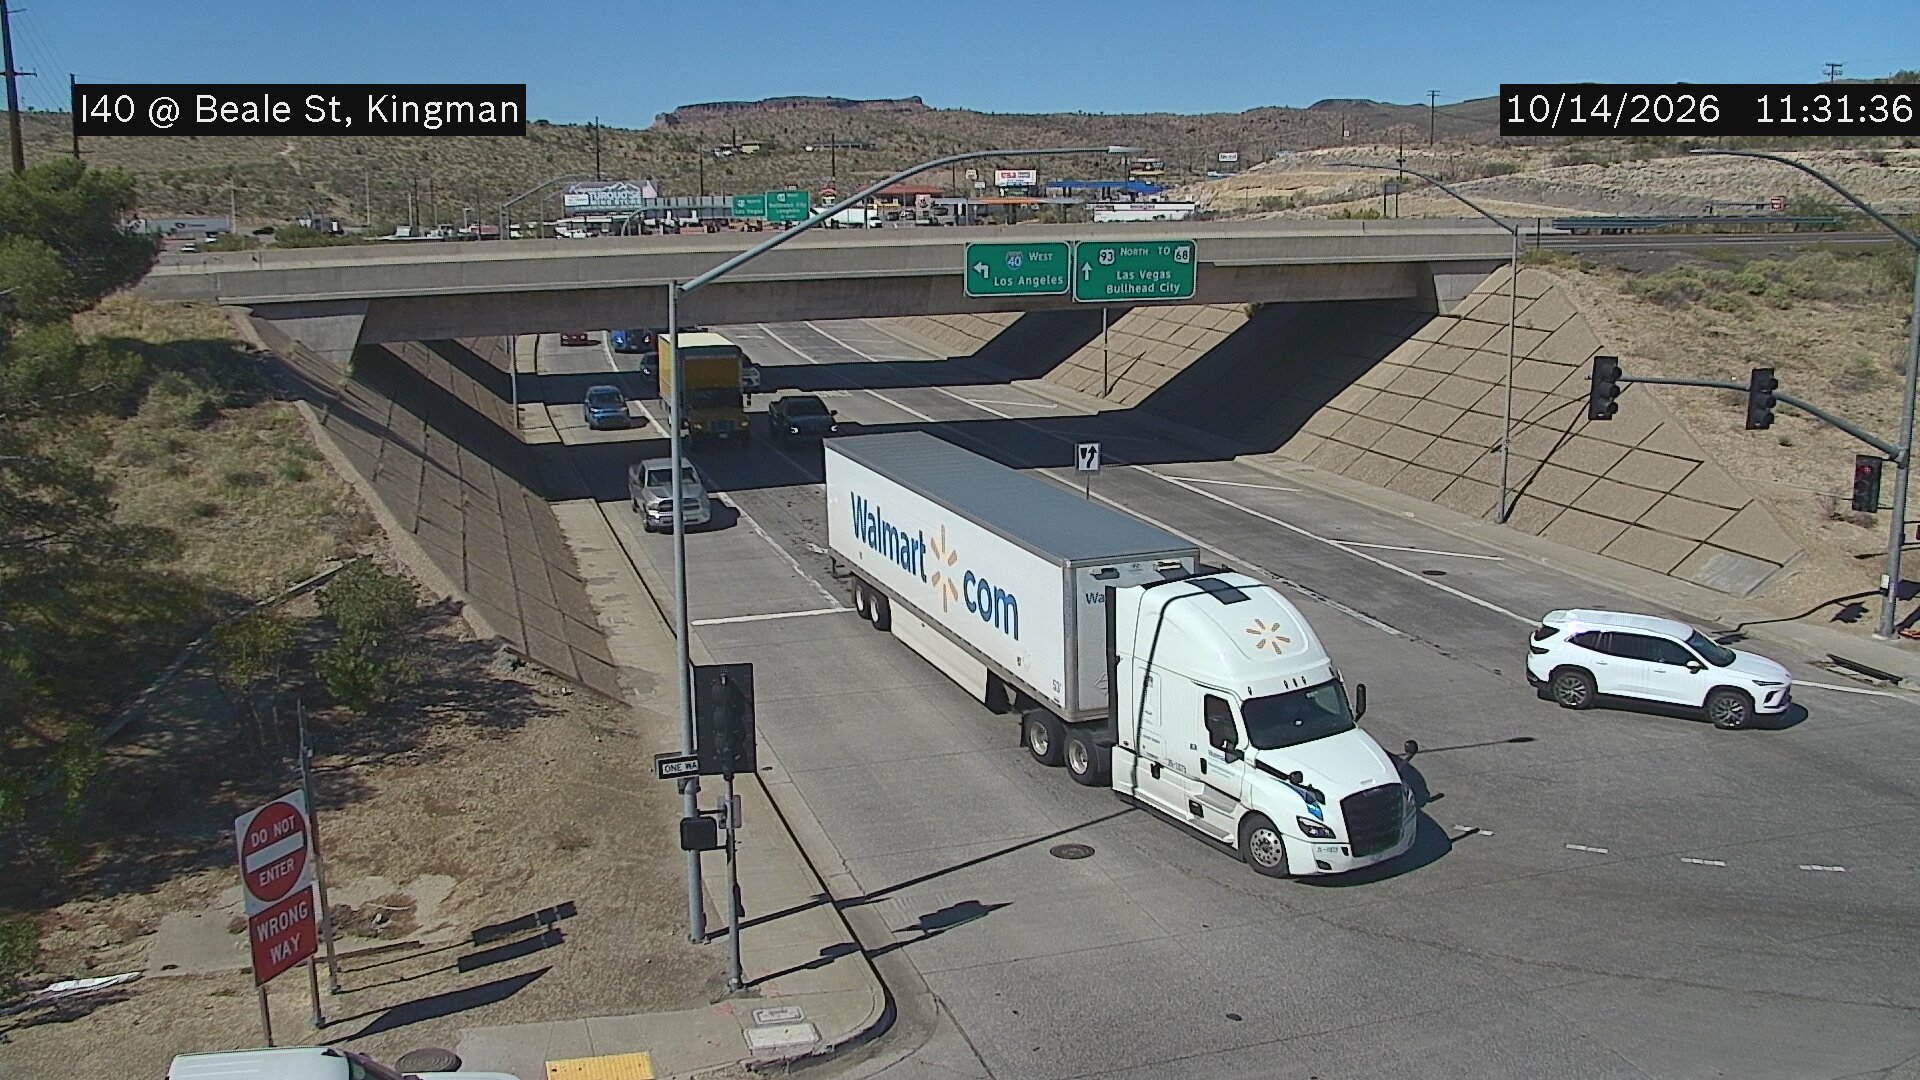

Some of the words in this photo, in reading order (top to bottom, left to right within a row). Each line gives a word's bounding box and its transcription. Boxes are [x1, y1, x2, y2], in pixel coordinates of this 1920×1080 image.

[1007, 255, 1021, 267] 40
[1100, 251, 1114, 262] 93
[1120, 247, 1149, 257] NORTH
[1158, 246, 1171, 255] TO
[1175, 250, 1189, 260] 68
[994, 277, 1013, 287] Los
[1018, 275, 1063, 288] Angeles
[1116, 271, 1135, 280] Las
[1140, 270, 1171, 282] Vegas
[1106, 283, 1155, 294] Bullhead
[1160, 282, 1181, 295] City
[850, 491, 928, 584] Walmart
[963, 569, 1019, 642] com
[1085, 592, 1106, 605] Wa
[664, 763, 682, 774] ONE
[685, 761, 698, 770] WA
[250, 829, 268, 848] DO
[273, 815, 295, 837] NOT
[259, 858, 295, 887] ENTER
[257, 900, 309, 943] WRONG
[270, 932, 301, 965] WAY
